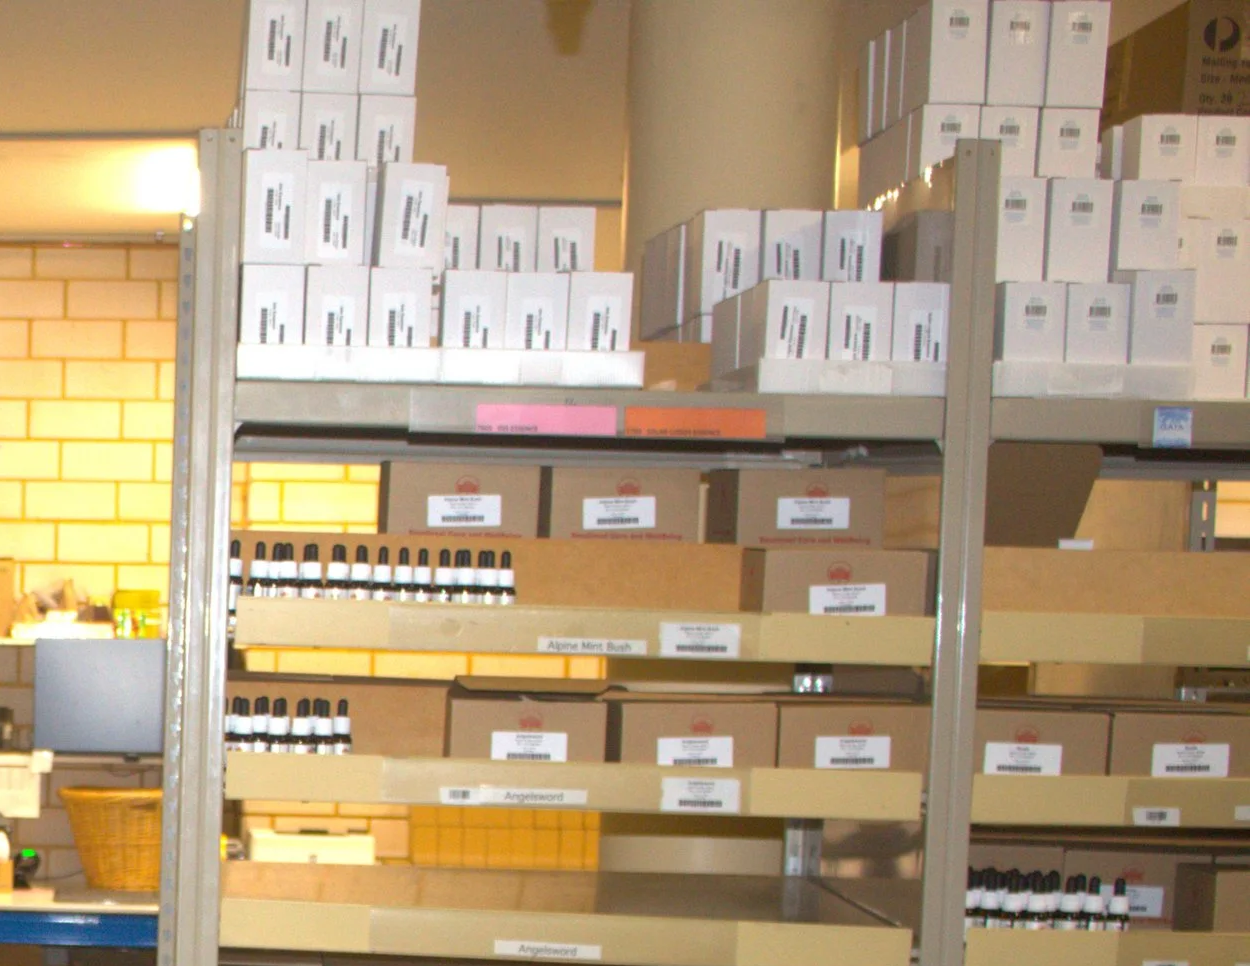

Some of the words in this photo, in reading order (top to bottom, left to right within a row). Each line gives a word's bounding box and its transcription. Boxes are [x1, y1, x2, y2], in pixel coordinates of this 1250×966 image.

[547, 640, 578, 652] Alpine
[582, 641, 603, 650] Mint
[607, 641, 632, 652] Bush
[504, 791, 564, 804] Angelsword
[518, 944, 577, 958] Angelsword
